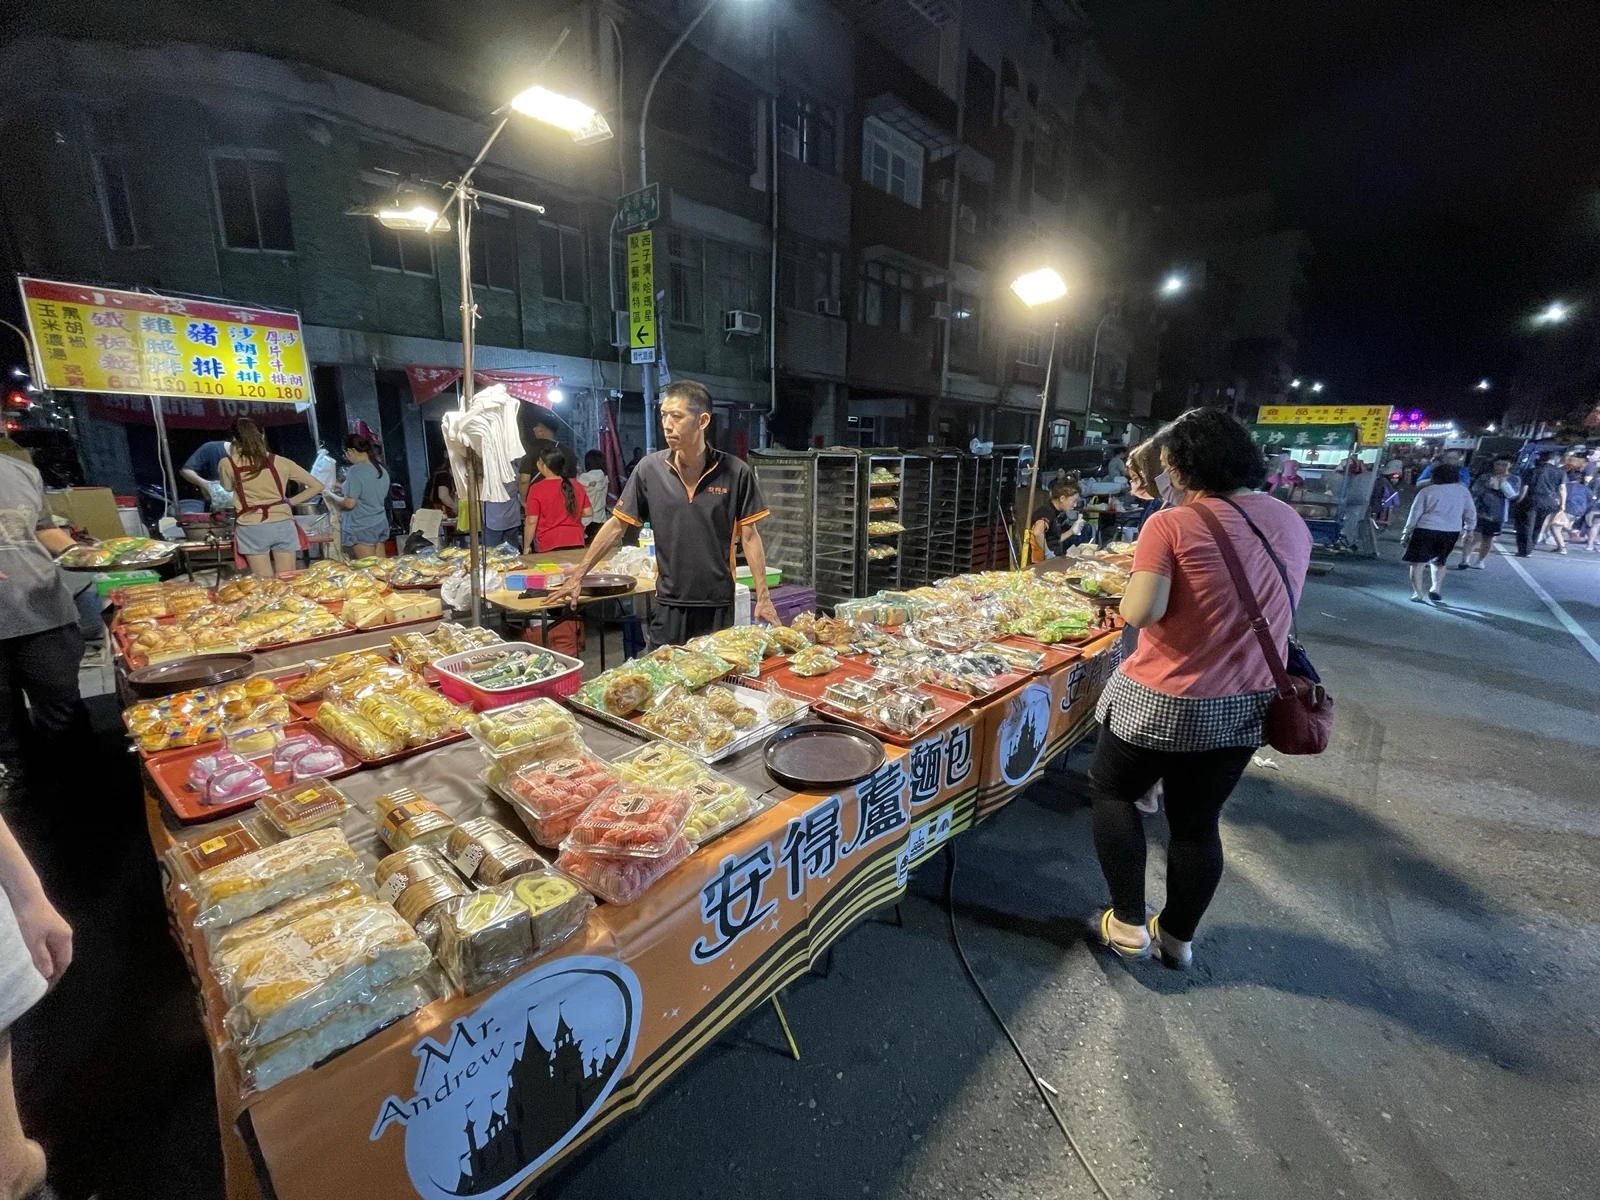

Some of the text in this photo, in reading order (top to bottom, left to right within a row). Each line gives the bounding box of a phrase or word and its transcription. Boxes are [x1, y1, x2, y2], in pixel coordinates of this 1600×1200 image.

[61, 306, 87, 349] 黑胡椒
[187, 322, 225, 380] 豬排
[229, 326, 261, 384] 沙朗牛排
[193, 381, 224, 396] 110
[238, 384, 266, 398] 120
[276, 387, 303, 400] 180
[418, 1016, 502, 1087] Mr.
[375, 1040, 506, 1136] Andrew
